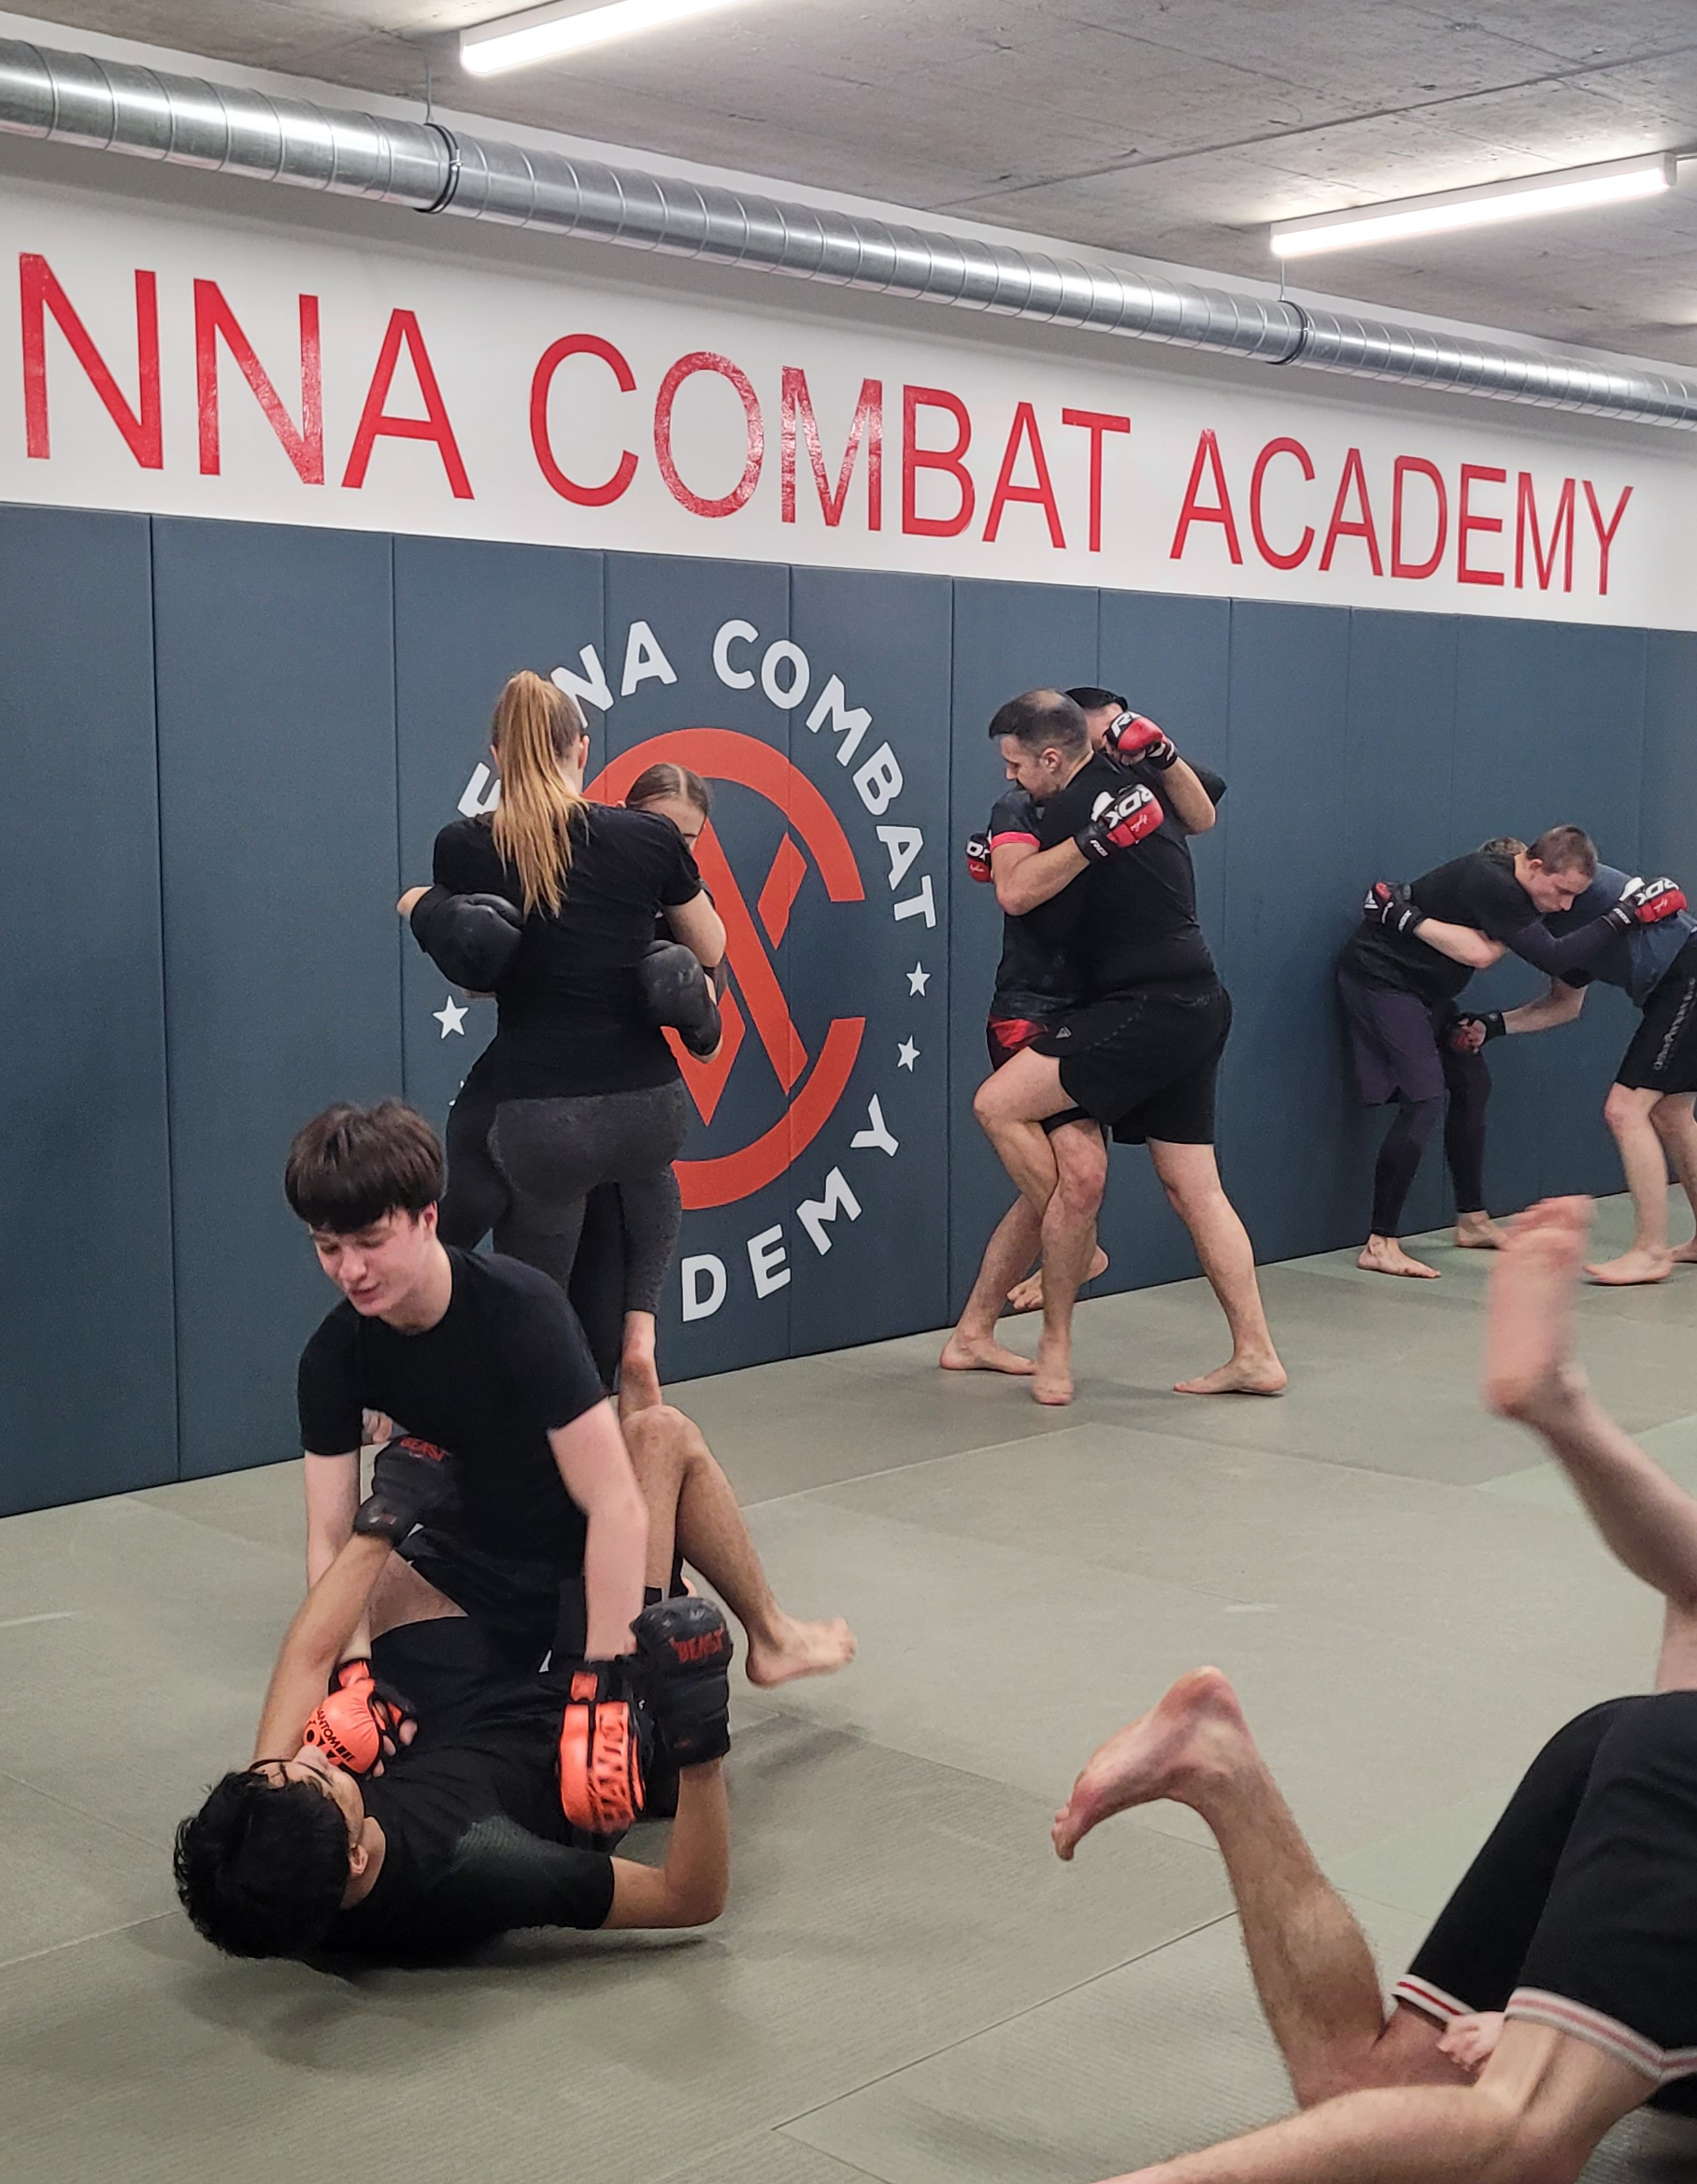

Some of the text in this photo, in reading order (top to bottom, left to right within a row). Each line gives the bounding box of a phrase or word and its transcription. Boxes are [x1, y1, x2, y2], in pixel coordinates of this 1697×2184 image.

[530, 334, 1131, 553] COMBAT
[1170, 430, 1633, 595] ACADEMY
[712, 620, 936, 929] COMBAT
